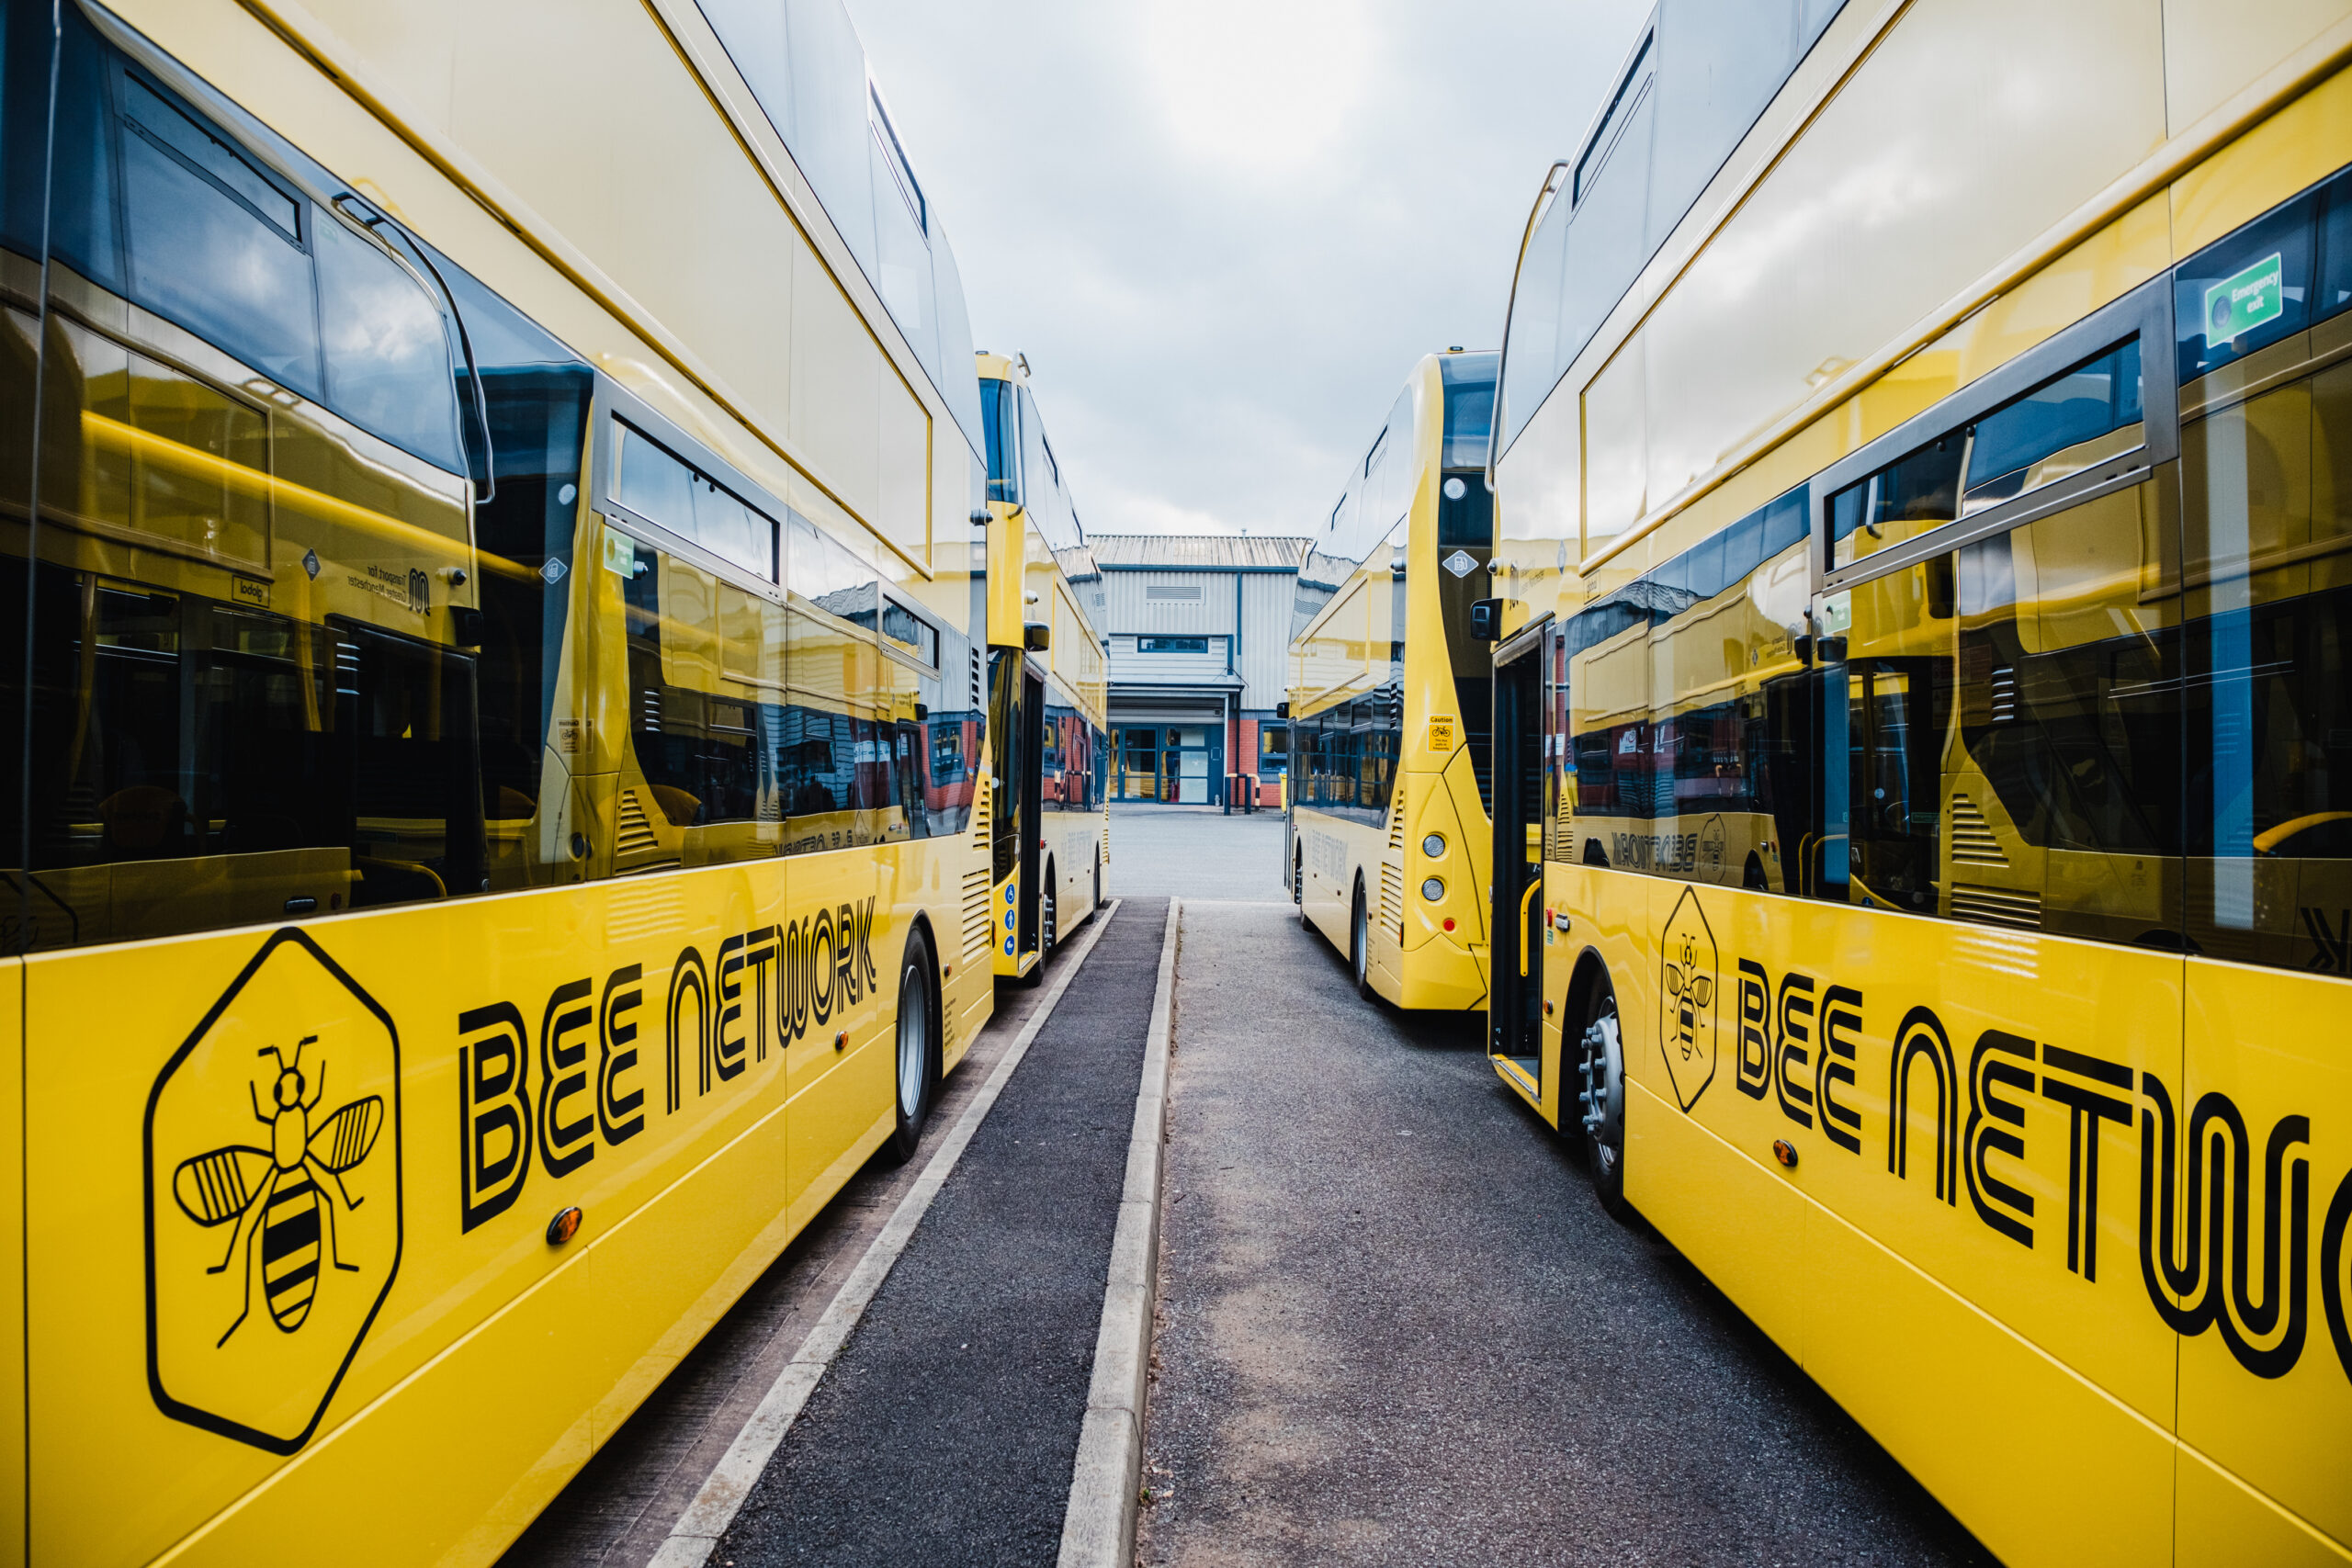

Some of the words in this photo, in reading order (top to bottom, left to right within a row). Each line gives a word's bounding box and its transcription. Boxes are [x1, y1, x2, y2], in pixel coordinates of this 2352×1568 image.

[2232, 270, 2278, 302] Emergency
[2247, 295, 2264, 313] exit
[458, 963, 645, 1235] BEE
[666, 895, 876, 1115] NETWORK
[1736, 957, 1862, 1156] BEE
[1888, 1005, 2352, 1386] NETW
